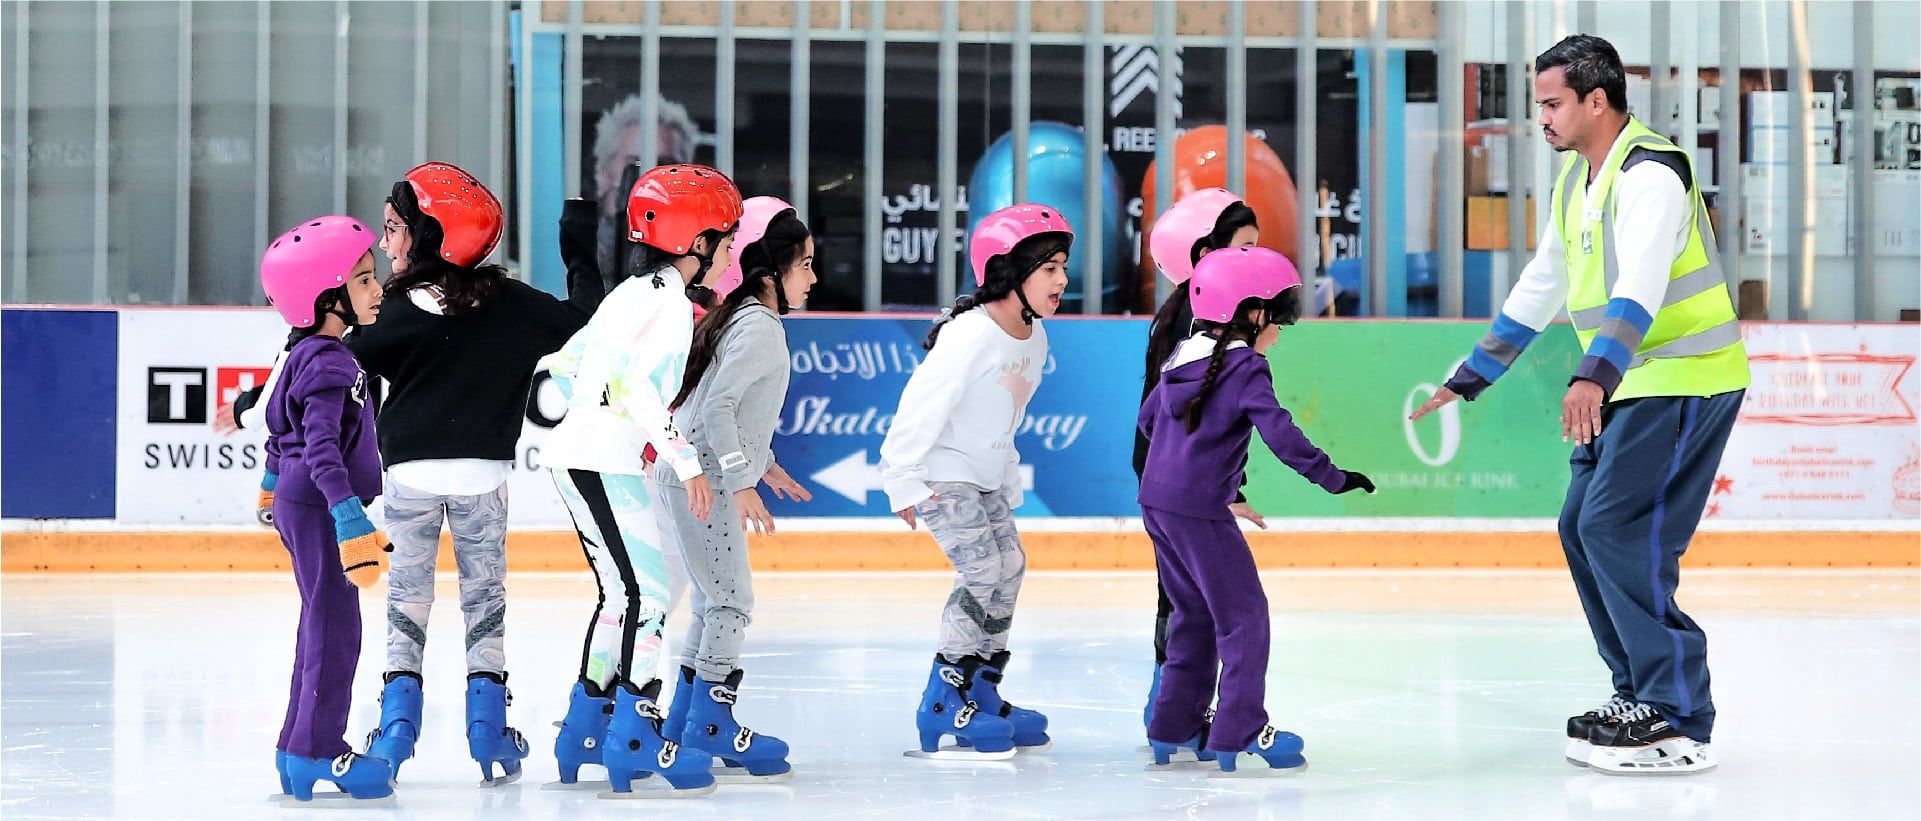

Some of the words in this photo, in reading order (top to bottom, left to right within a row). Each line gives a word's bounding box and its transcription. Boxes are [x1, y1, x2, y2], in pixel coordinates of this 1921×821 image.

[1113, 127, 1157, 152] REE
[883, 227, 939, 263] GUY
[791, 340, 885, 380] الاتجاه
[145, 443, 257, 469] SWISS
